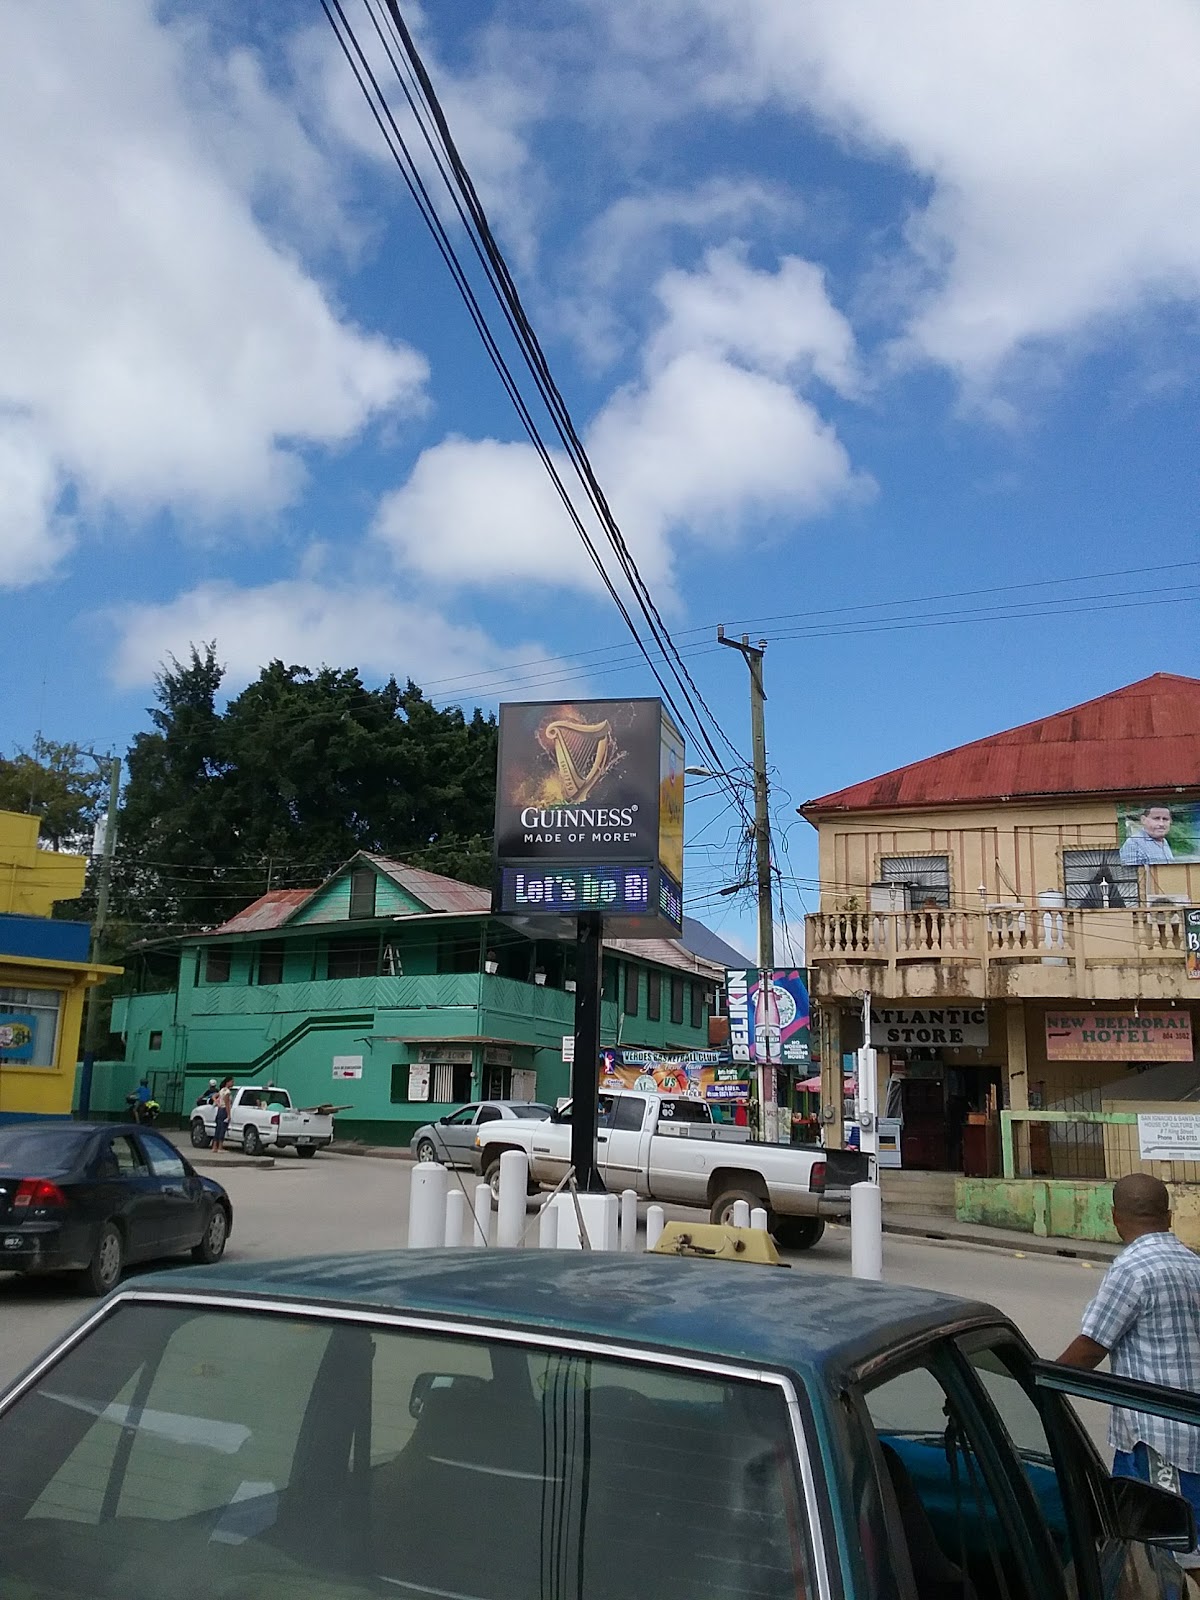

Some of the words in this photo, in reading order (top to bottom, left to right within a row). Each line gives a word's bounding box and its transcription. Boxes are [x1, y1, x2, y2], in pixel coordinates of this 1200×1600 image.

[520, 806, 632, 828] GUINNESS
[524, 833, 562, 843] MADE
[568, 833, 586, 843] OF
[516, 874, 576, 903] Let's
[583, 874, 617, 903] be
[727, 970, 750, 1061] BELIKIN
[869, 1010, 985, 1024] ATLANTIC
[1047, 1017, 1085, 1029] NEW
[1095, 1017, 1189, 1029] BELMORAL
[887, 1028, 964, 1043] STORE
[1082, 1030, 1154, 1043] HOTEL
[624, 1050, 654, 1061] VERDES
[654, 1051, 698, 1063] BASKETBALL
[699, 1051, 718, 1062] CLUB
[663, 1077, 676, 1087] VS
